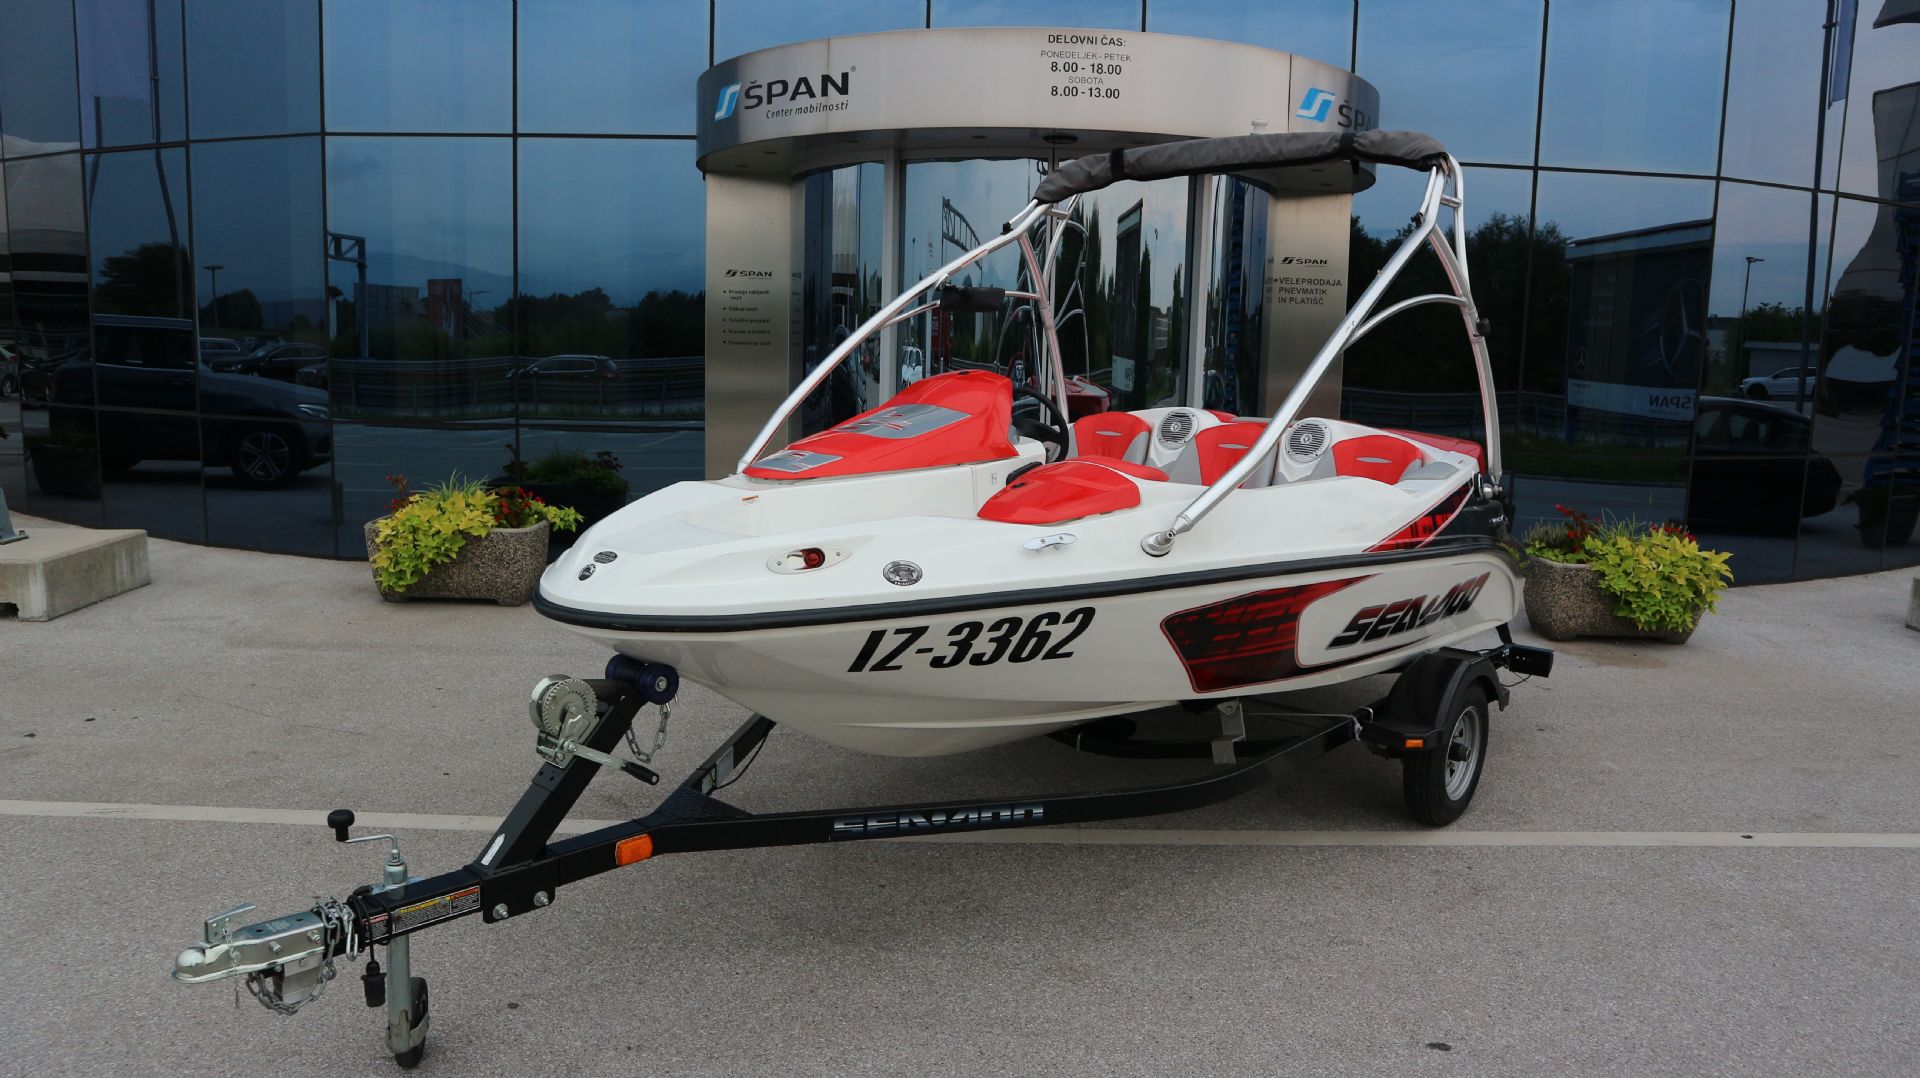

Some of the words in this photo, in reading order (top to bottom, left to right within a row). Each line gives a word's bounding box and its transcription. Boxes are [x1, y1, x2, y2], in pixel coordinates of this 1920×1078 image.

[1048, 34, 1098, 45] DELOVNI
[1100, 35, 1126, 47] ČAS:
[1040, 50, 1098, 60] PONEDELJEK
[1104, 52, 1131, 62] PETEK
[1051, 61, 1078, 73] 8.00
[1089, 63, 1122, 75] 18.00
[1068, 75, 1104, 85] SOBOTA
[744, 72, 849, 110] ŠPAN
[1051, 85, 1078, 97] 8.00
[1088, 87, 1120, 99] 13.00
[766, 107, 793, 119] Center
[795, 100, 849, 115] mobilnosti
[1337, 98, 1373, 132] ŠPA
[1279, 277, 1342, 287] VELEPRODAJA
[1278, 286, 1327, 296] PNEVMATIK
[1278, 296, 1287, 304] IN
[847, 606, 1096, 673] IZ-3362
